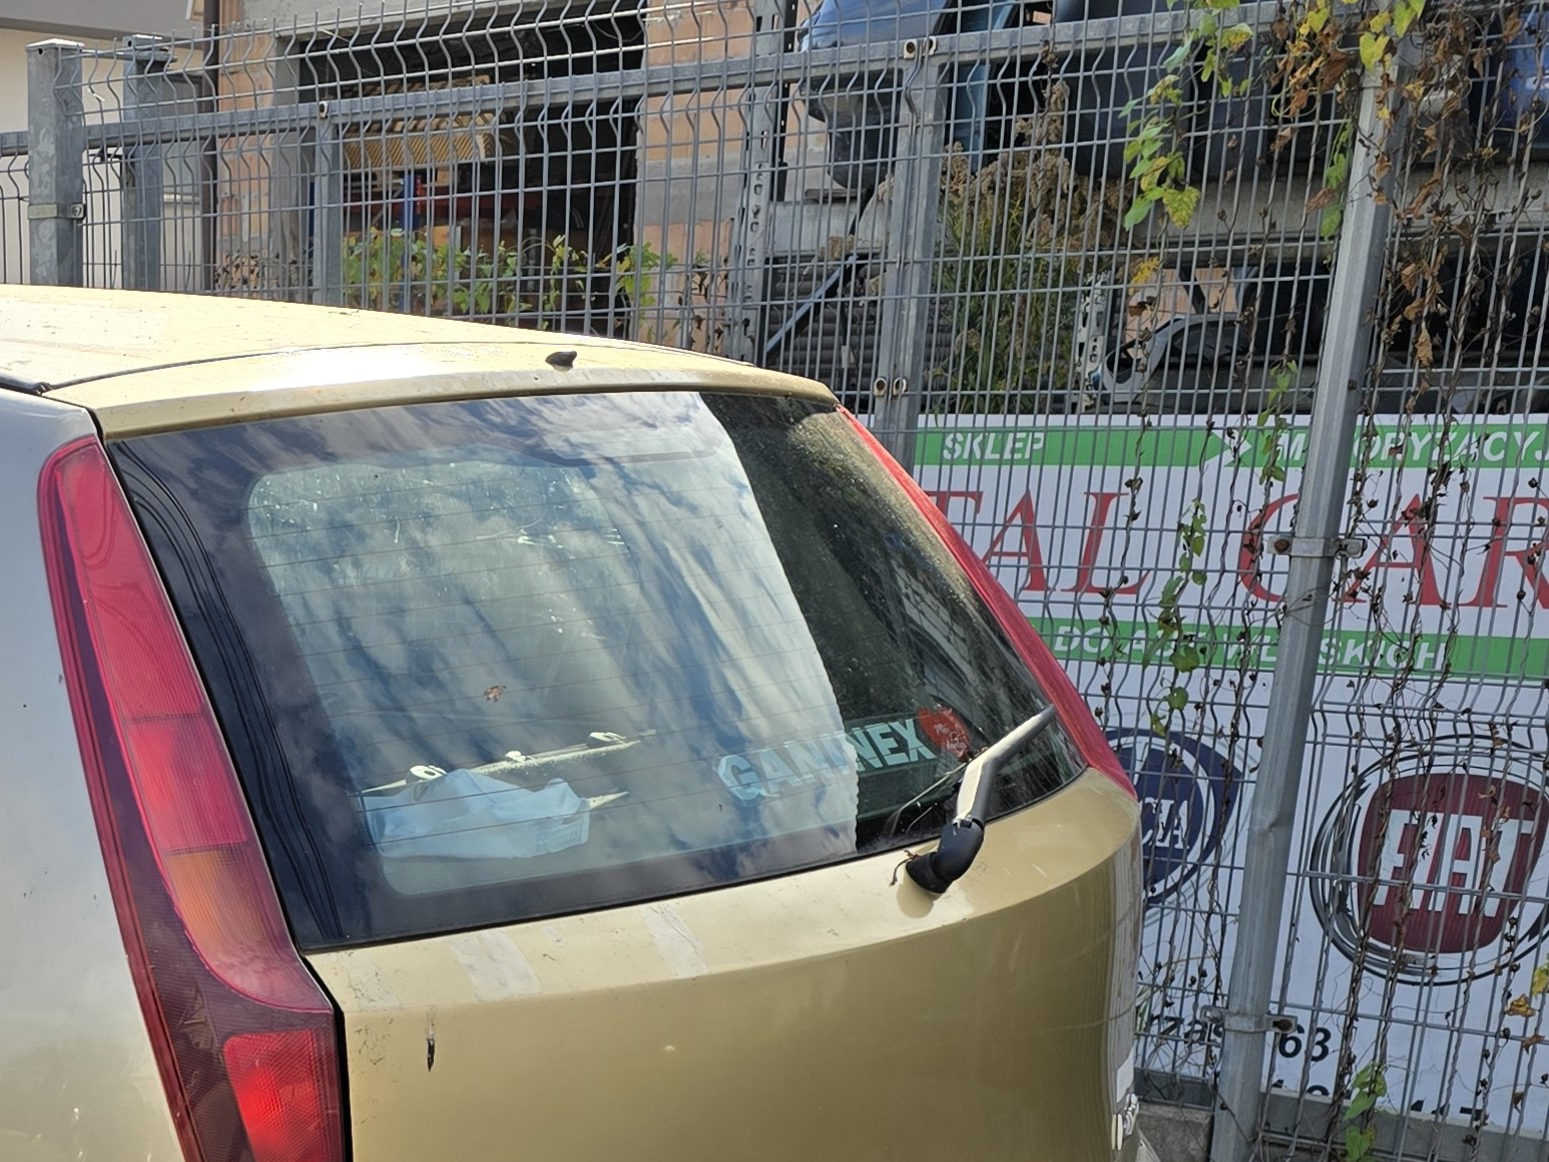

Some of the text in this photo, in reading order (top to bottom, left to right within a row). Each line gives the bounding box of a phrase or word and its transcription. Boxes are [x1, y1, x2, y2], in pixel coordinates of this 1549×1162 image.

[943, 432, 1045, 461] SKLEP
[1239, 493, 1549, 609] CAR
[1054, 625, 1110, 655] DO
[1373, 808, 1535, 918] FIAT
[1278, 1023, 1330, 1062] 63
